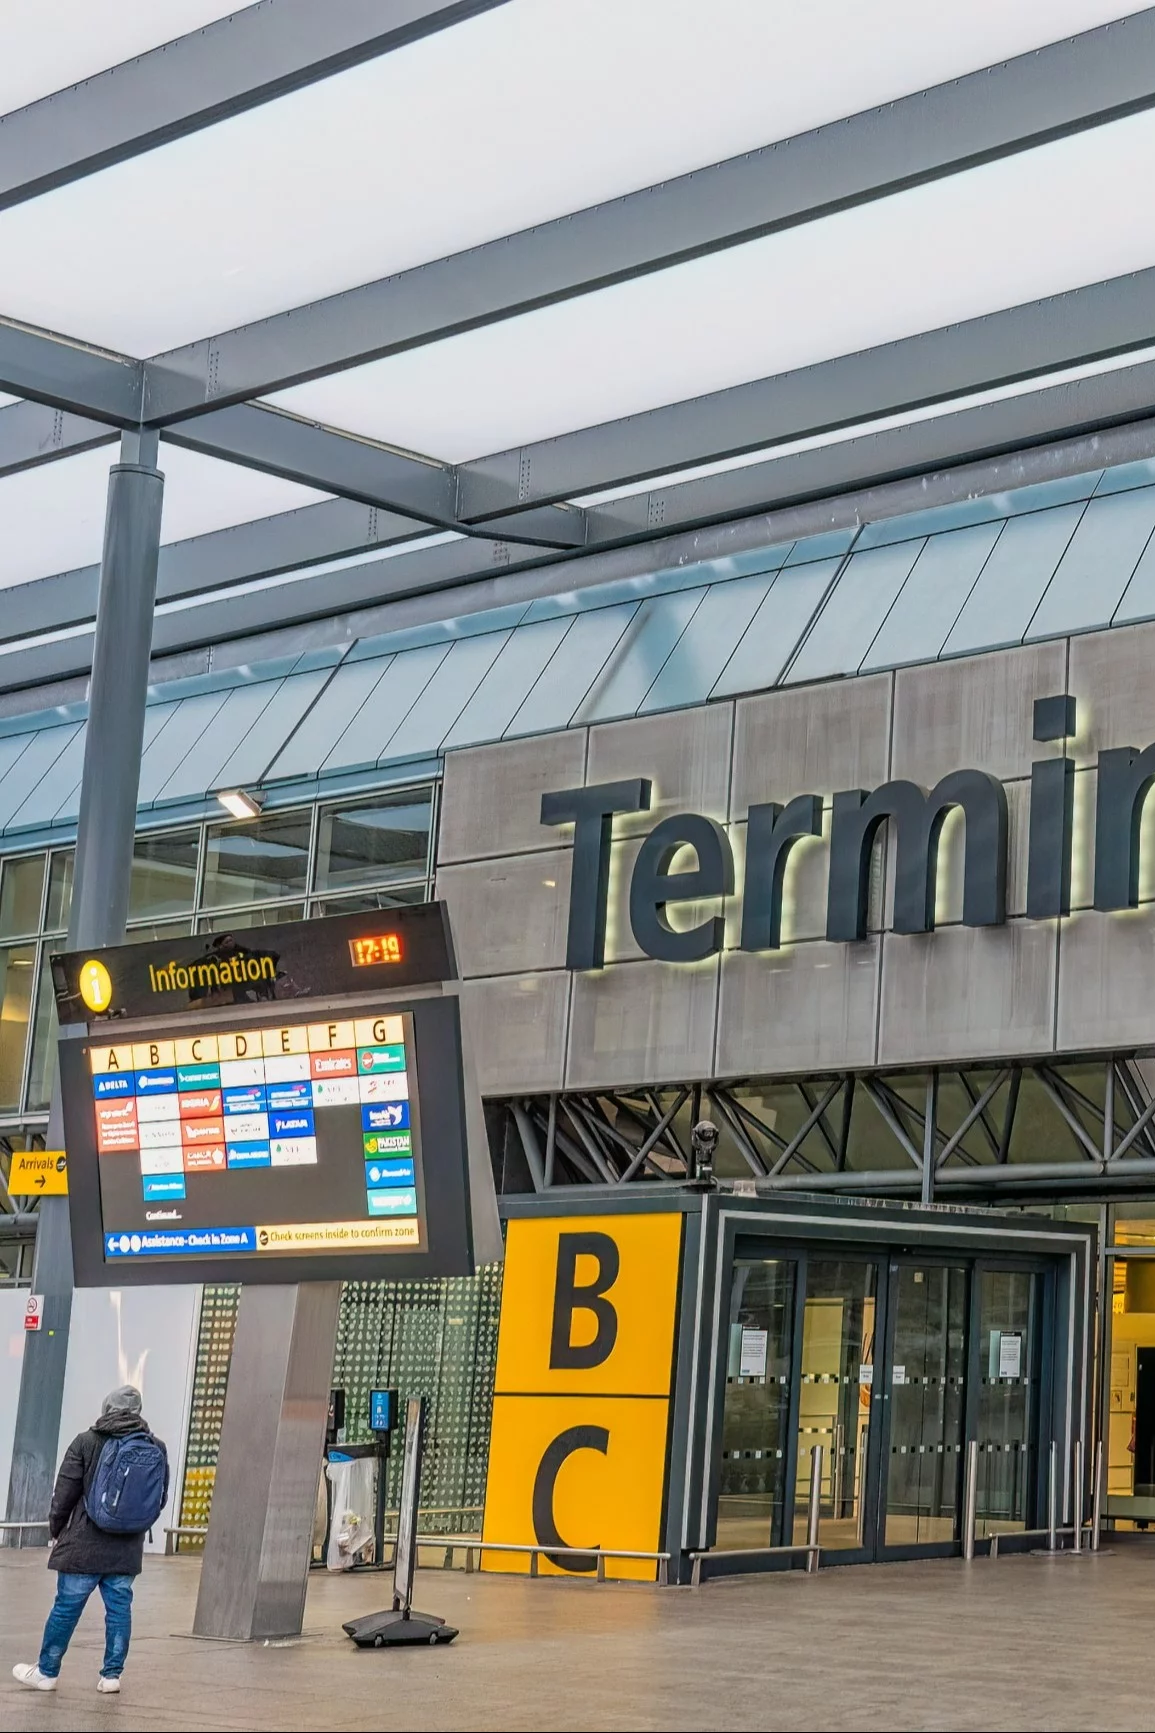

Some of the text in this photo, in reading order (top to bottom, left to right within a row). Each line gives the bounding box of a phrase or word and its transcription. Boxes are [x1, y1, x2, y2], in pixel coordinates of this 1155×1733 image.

[356, 937, 400, 963] 17:19
[149, 952, 276, 993] Information
[281, 1030, 290, 1052] E
[328, 1025, 337, 1047] F
[373, 1020, 386, 1042] G
[150, 1045, 160, 1065] B
[191, 1040, 202, 1061] C
[235, 1035, 247, 1057] D
[108, 1049, 119, 1070] A
[19, 1157, 54, 1170] Arrivals
[141, 1234, 184, 1248] Assistance
[188, 1233, 211, 1246] Check
[220, 1233, 240, 1245] Zone
[240, 1232, 248, 1244] A
[270, 1226, 415, 1242] Check screens inside to confirm zone
[549, 1231, 620, 1370] B
[532, 1424, 611, 1572] C
